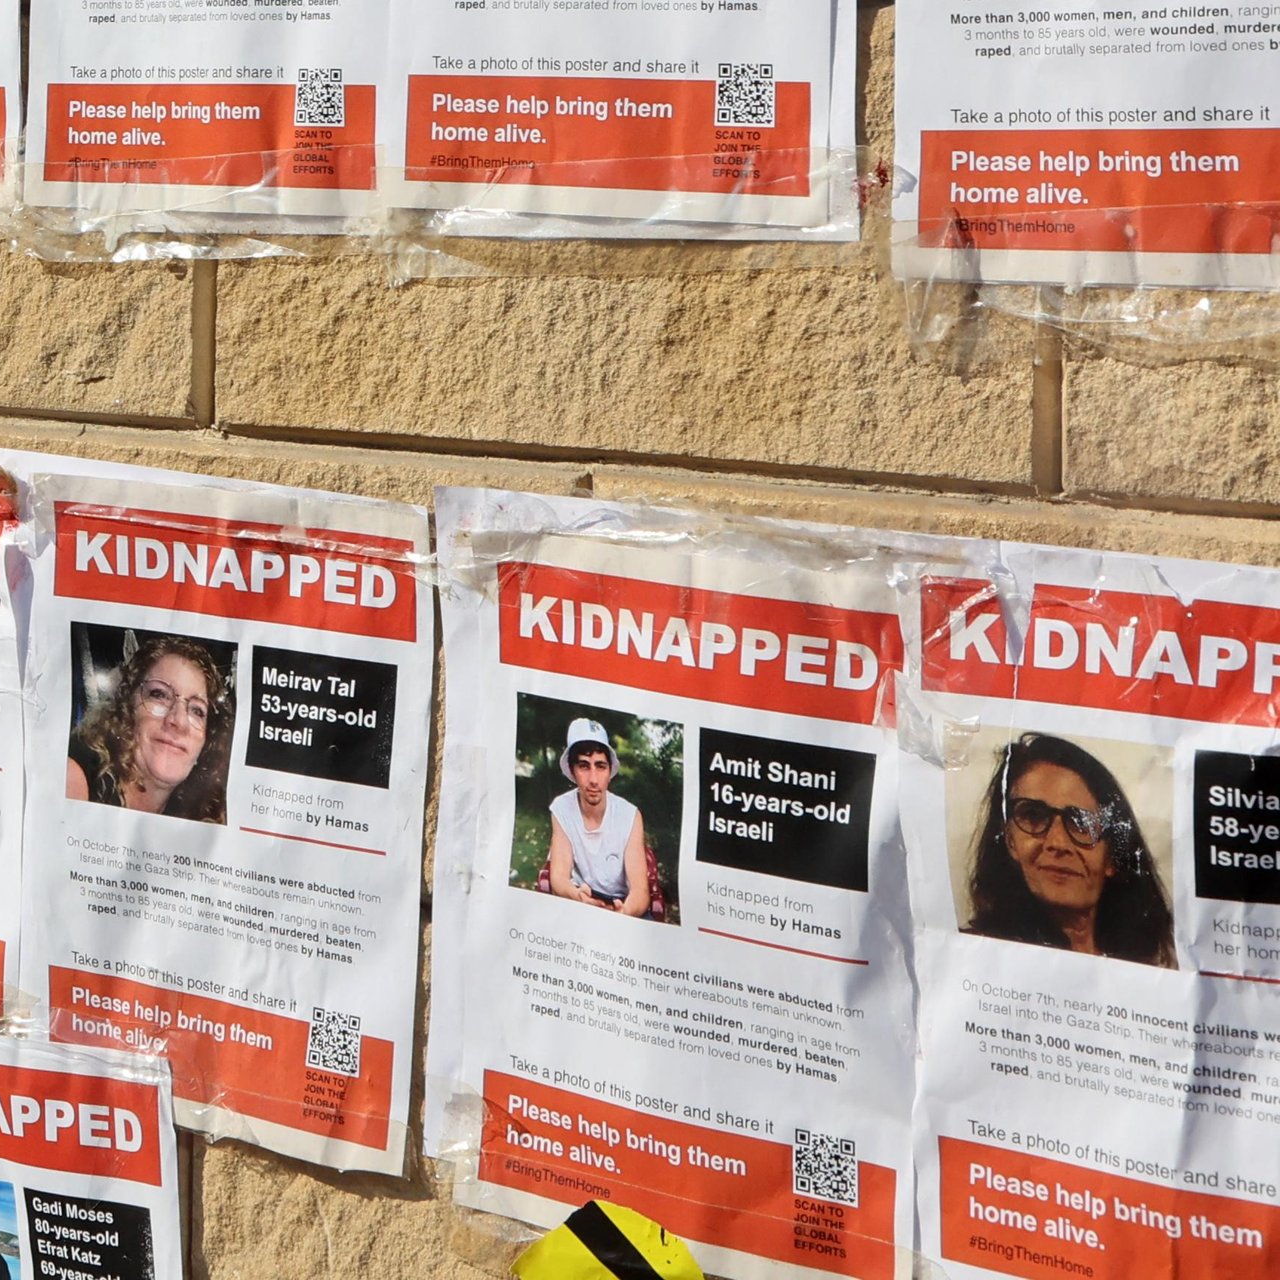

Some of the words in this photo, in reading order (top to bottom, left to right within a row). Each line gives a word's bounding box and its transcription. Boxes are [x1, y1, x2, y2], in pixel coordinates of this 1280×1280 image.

[715, 130, 744, 140] SCAN
[746, 131, 761, 141] TO
[76, 530, 396, 608] KIDNAPPED
[520, 593, 878, 690] KIDNAPPED
[262, 667, 322, 692] Meirav
[327, 676, 355, 698] Tal
[261, 694, 376, 728] 53-years-old
[259, 722, 313, 746] Israeli
[710, 752, 761, 779] Amit
[767, 762, 836, 791] Shani
[711, 782, 851, 824] 16-years-old
[1209, 785, 1279, 810] Silvia
[709, 813, 773, 842] Israeli
[770, 914, 787, 931] by
[792, 918, 841, 939] Hamas
[505, 1159, 611, 1199] #BringThemHome
[32, 1197, 62, 1216] Gadi
[66, 1203, 114, 1224] Moses
[794, 1226, 842, 1245] GLOBAL
[794, 1238, 847, 1259] EFFORTS
[37, 1239, 69, 1259] Efrat
[71, 1246, 101, 1266] Katz
